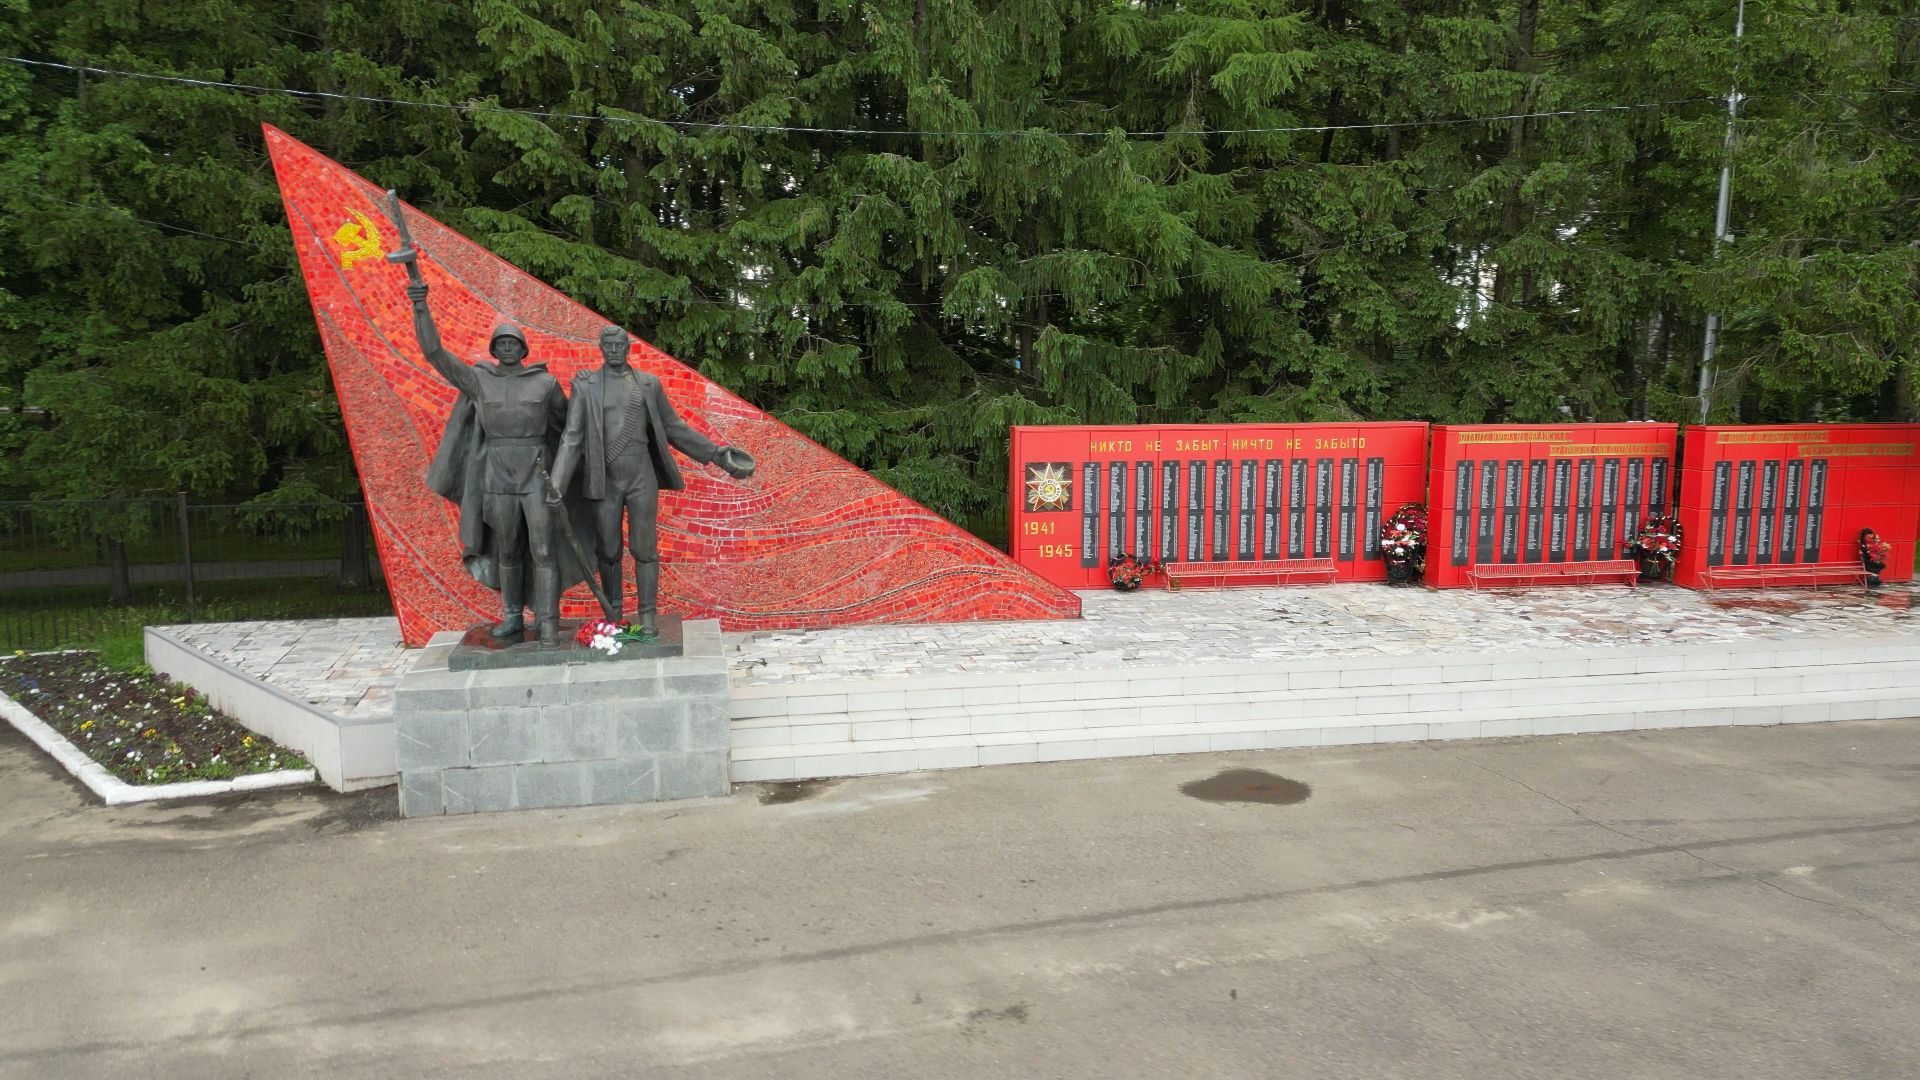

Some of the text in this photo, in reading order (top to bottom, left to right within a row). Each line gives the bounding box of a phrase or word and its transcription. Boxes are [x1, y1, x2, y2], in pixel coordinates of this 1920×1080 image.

[1090, 440, 1132, 453] НИКТО
[1145, 440, 1162, 452] НЕ
[1232, 438, 1273, 450] НИЧТО
[1286, 438, 1302, 450] НЕ
[1315, 437, 1366, 450] ЗАБЫТО
[1024, 521, 1055, 535] 1941
[1039, 544, 1073, 558] 1945
